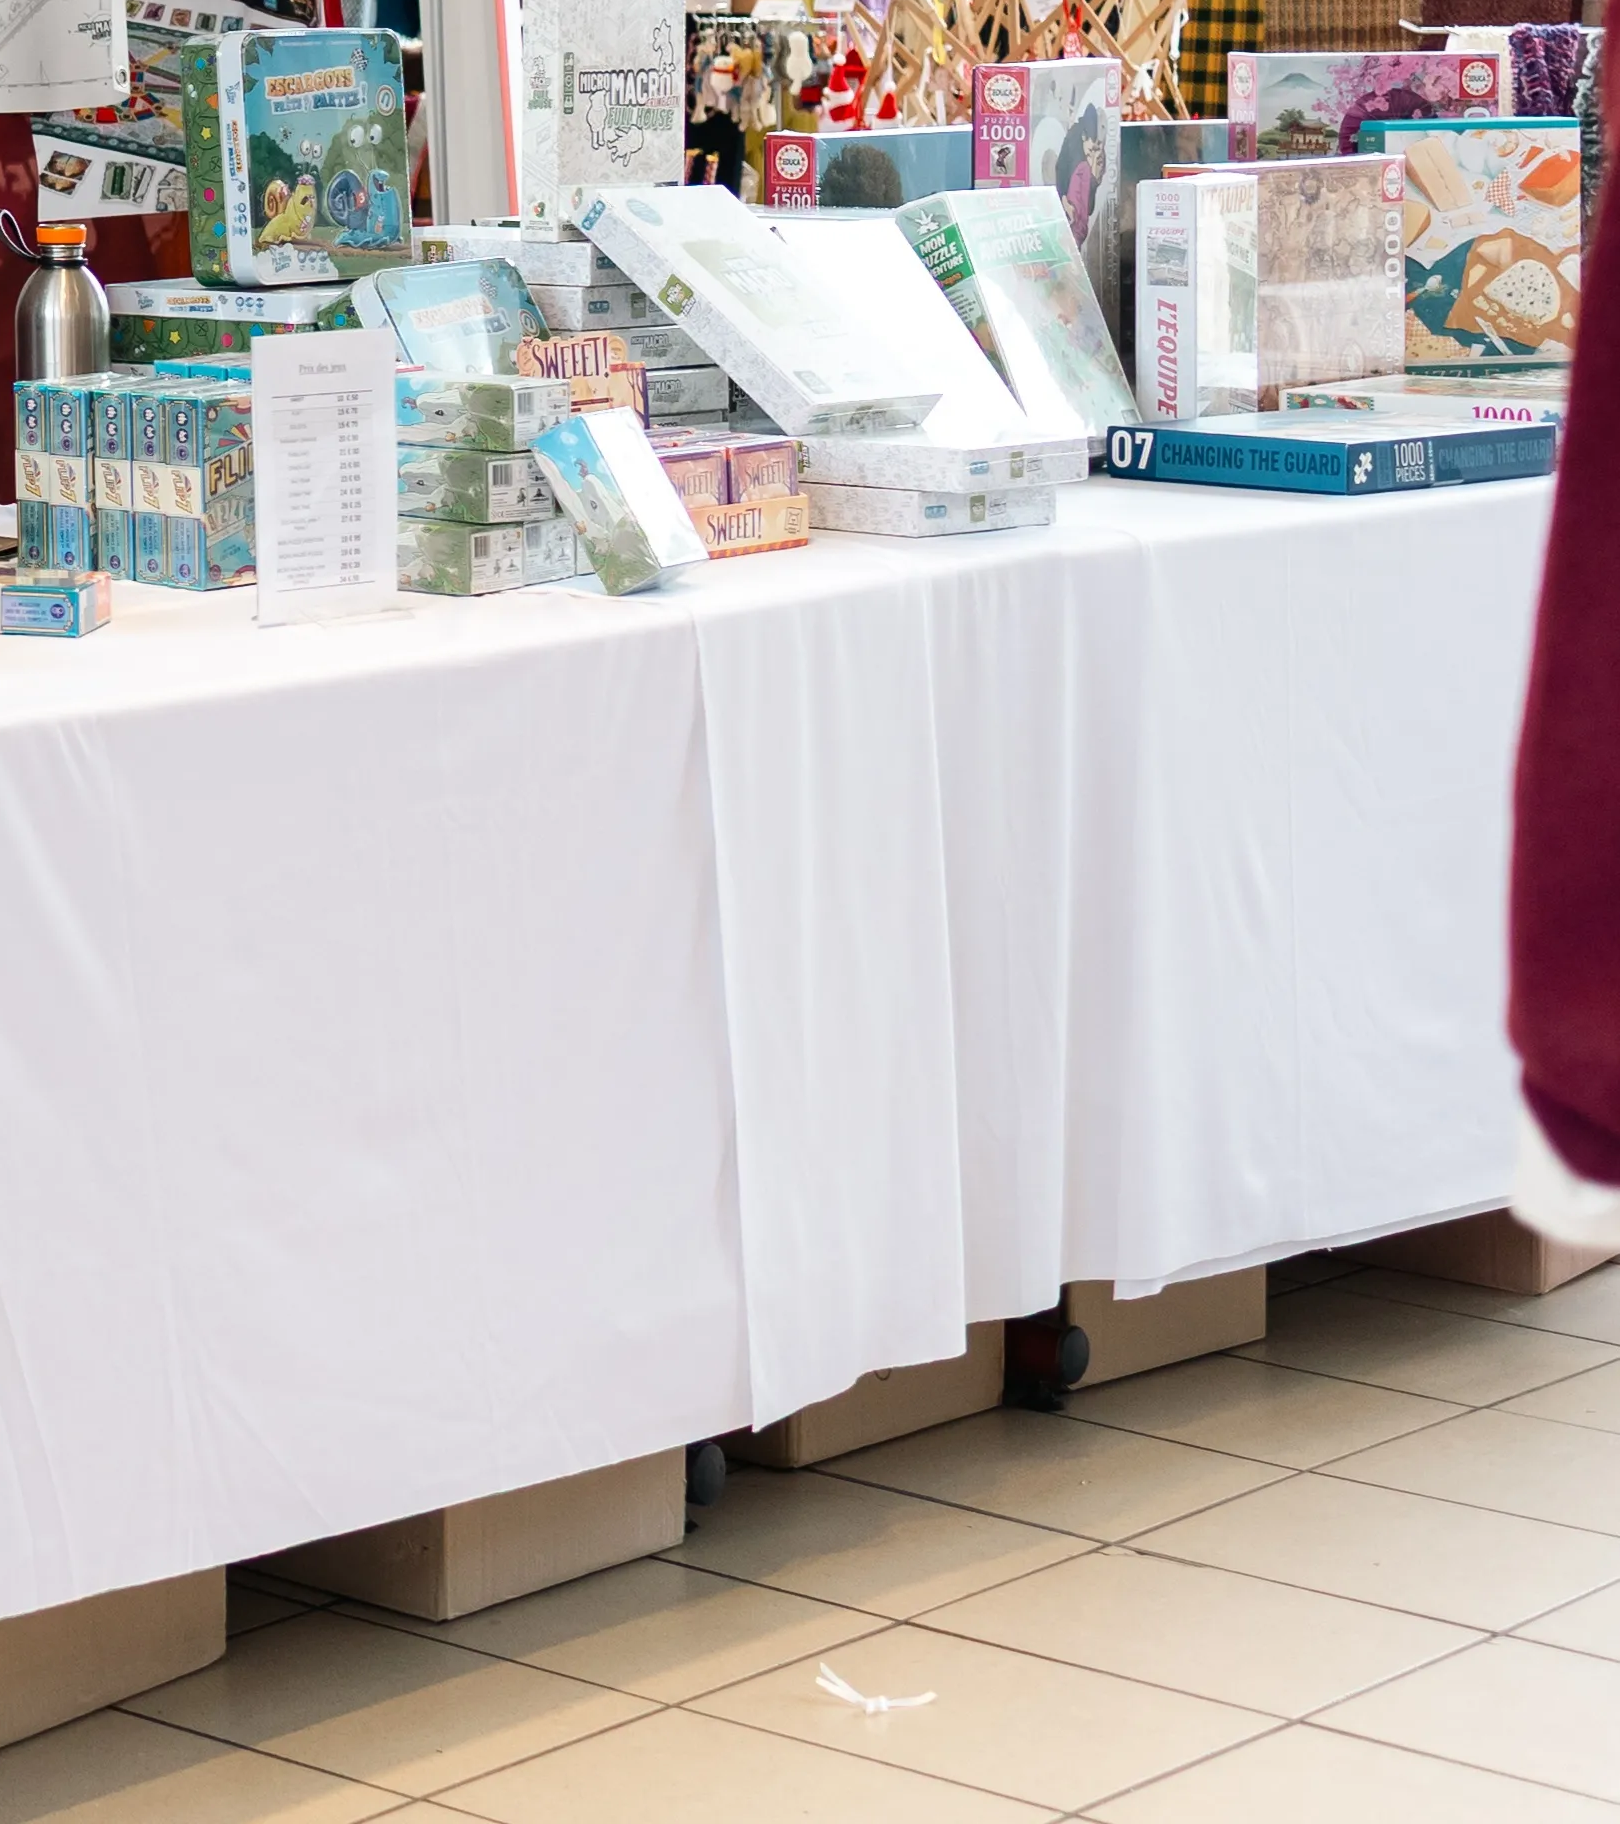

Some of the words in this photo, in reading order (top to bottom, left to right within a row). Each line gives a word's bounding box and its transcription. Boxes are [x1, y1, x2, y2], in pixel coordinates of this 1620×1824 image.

[266, 67, 355, 98] ESCARGOTS
[608, 106, 636, 128] FULL
[637, 108, 675, 131] HOUSE
[984, 116, 1020, 125] PUZZLE
[979, 125, 1026, 141] 1000
[782, 157, 801, 167] EDUCA
[775, 185, 808, 193] PUZZLE
[1155, 193, 1180, 203] 1000
[771, 193, 812, 209] 1500
[918, 232, 946, 255] MON
[930, 256, 965, 277] ENTURE
[1384, 211, 1402, 300] 1000
[317, 362, 329, 373] des
[532, 336, 610, 381] SWEEET!
[1157, 298, 1179, 418] L'ÉQUIPE
[1111, 429, 1155, 470] 07
[1161, 441, 1244, 471] CHANGING
[1248, 446, 1280, 472] THE
[1284, 449, 1342, 477] GUARD
[1393, 441, 1424, 465] 1000
[1438, 442, 1494, 470] CHANGING
[1496, 440, 1517, 464] THE
[1518, 438, 1552, 462] GUARD
[1395, 464, 1427, 482] PIECES
[705, 507, 762, 546] SWEEET!
